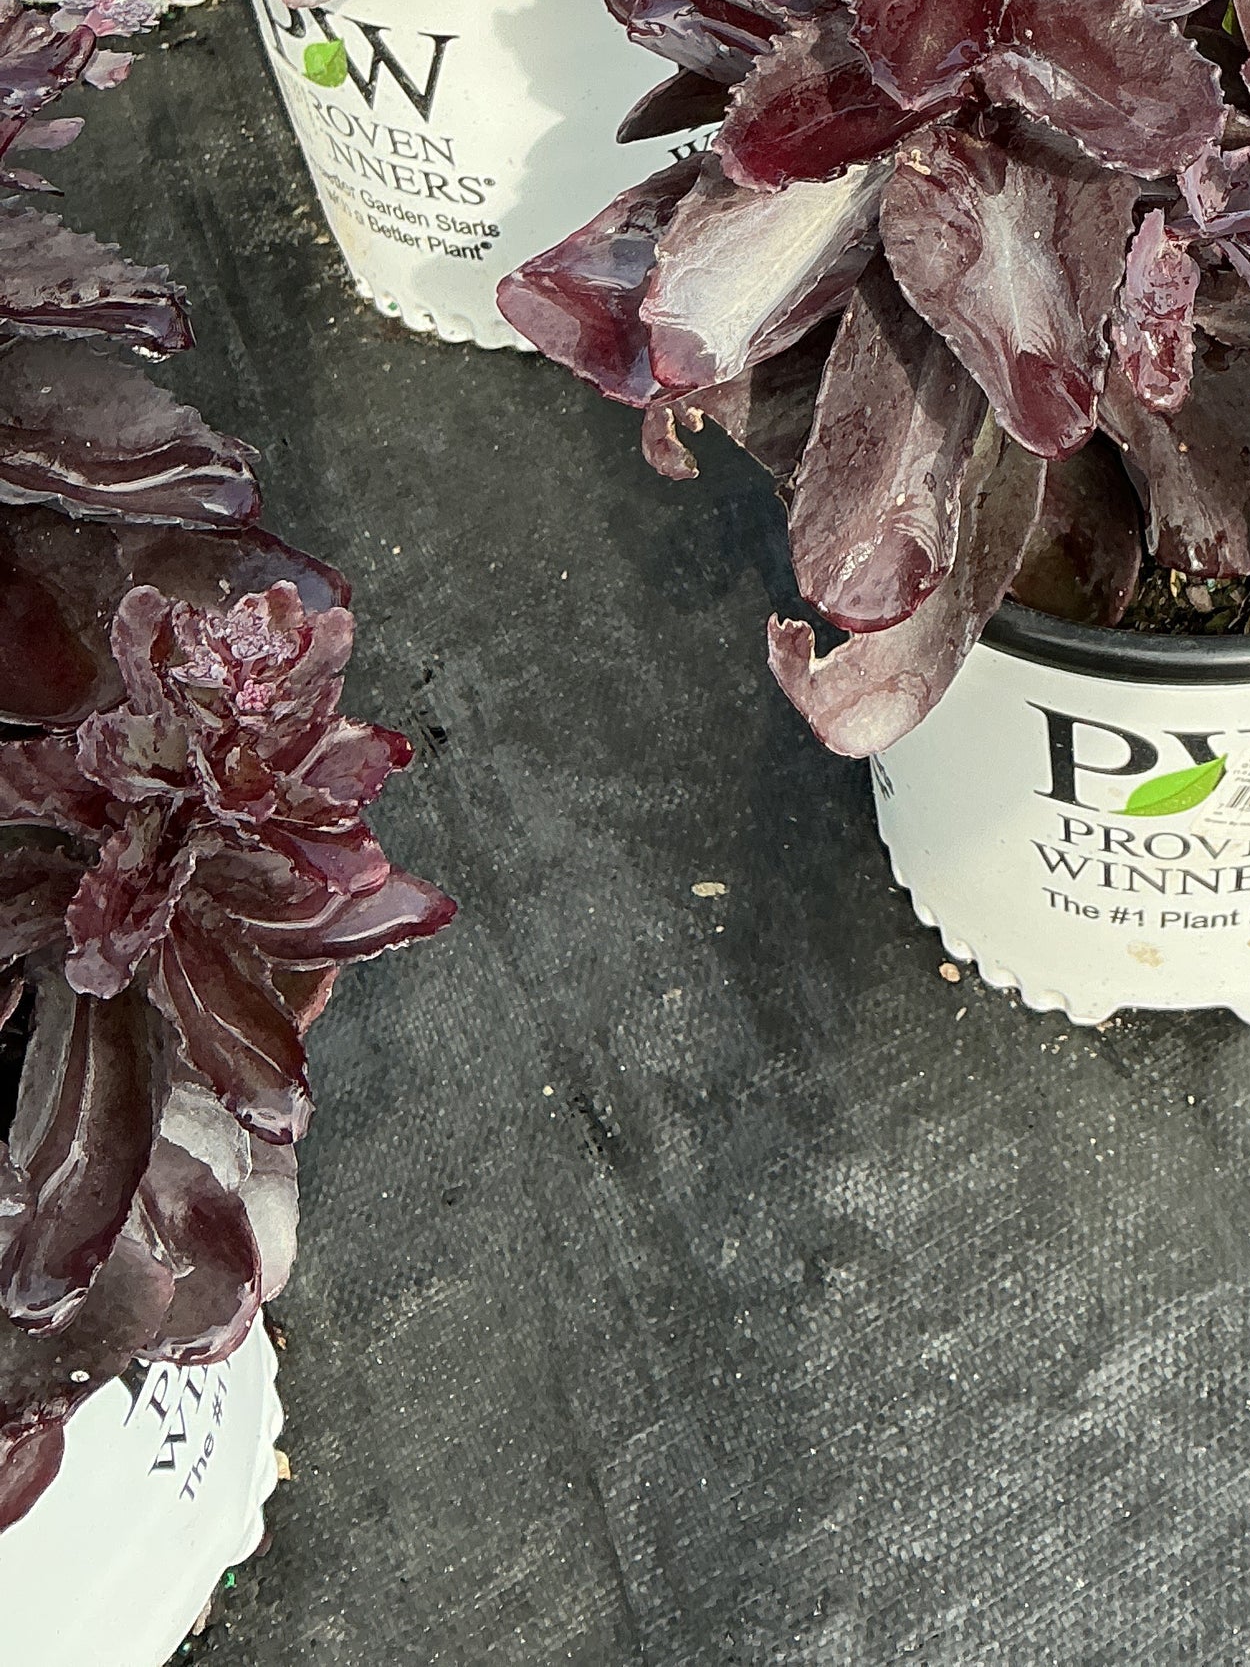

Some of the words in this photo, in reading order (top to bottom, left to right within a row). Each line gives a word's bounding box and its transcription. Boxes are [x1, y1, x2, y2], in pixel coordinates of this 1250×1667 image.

[302, 88, 456, 167] ROVEN
[360, 189, 431, 228] Garden
[435, 213, 501, 239] Starts
[367, 213, 423, 247] Better
[1042, 887, 1101, 921] The
[1109, 906, 1145, 928] #1
[1160, 911, 1241, 930] Plant
[179, 1431, 215, 1502] The
